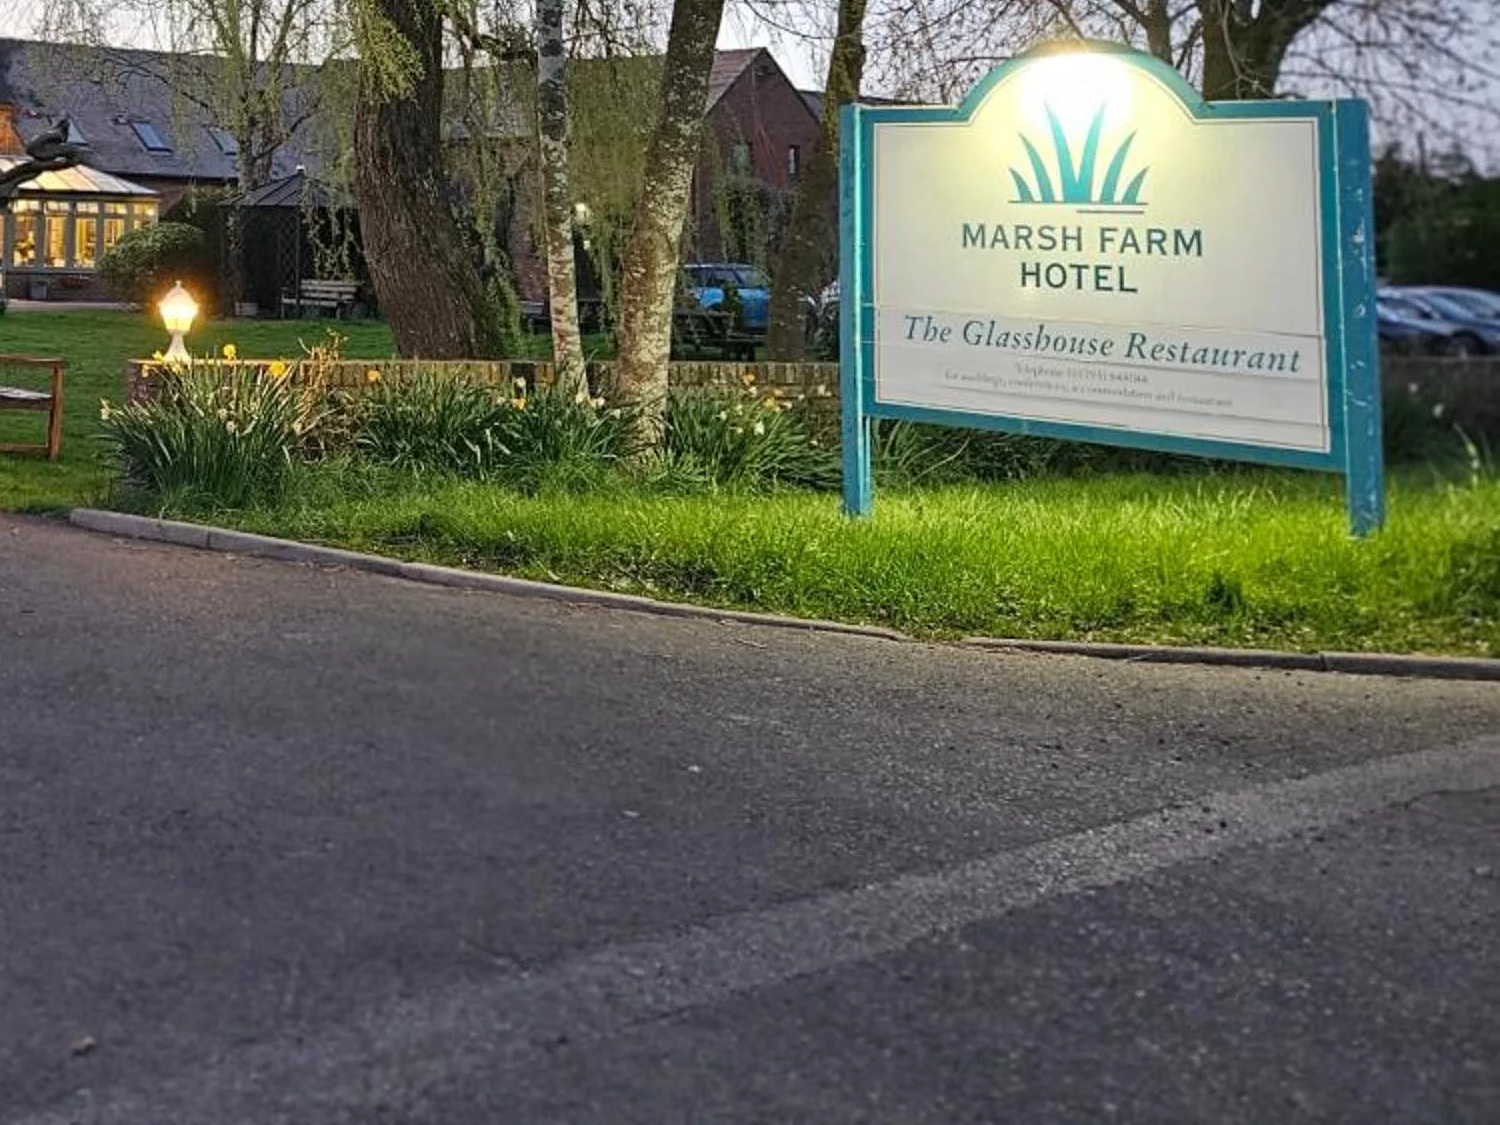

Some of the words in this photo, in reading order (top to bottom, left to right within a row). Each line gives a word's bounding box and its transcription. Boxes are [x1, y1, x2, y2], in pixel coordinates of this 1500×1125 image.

[962, 224, 1082, 251] MARSH
[1100, 227, 1202, 256] FARM
[1021, 262, 1138, 292] HOTEL
[905, 315, 952, 342] The
[963, 320, 1114, 356] Glasshouse
[1124, 332, 1300, 372] Restaurant
